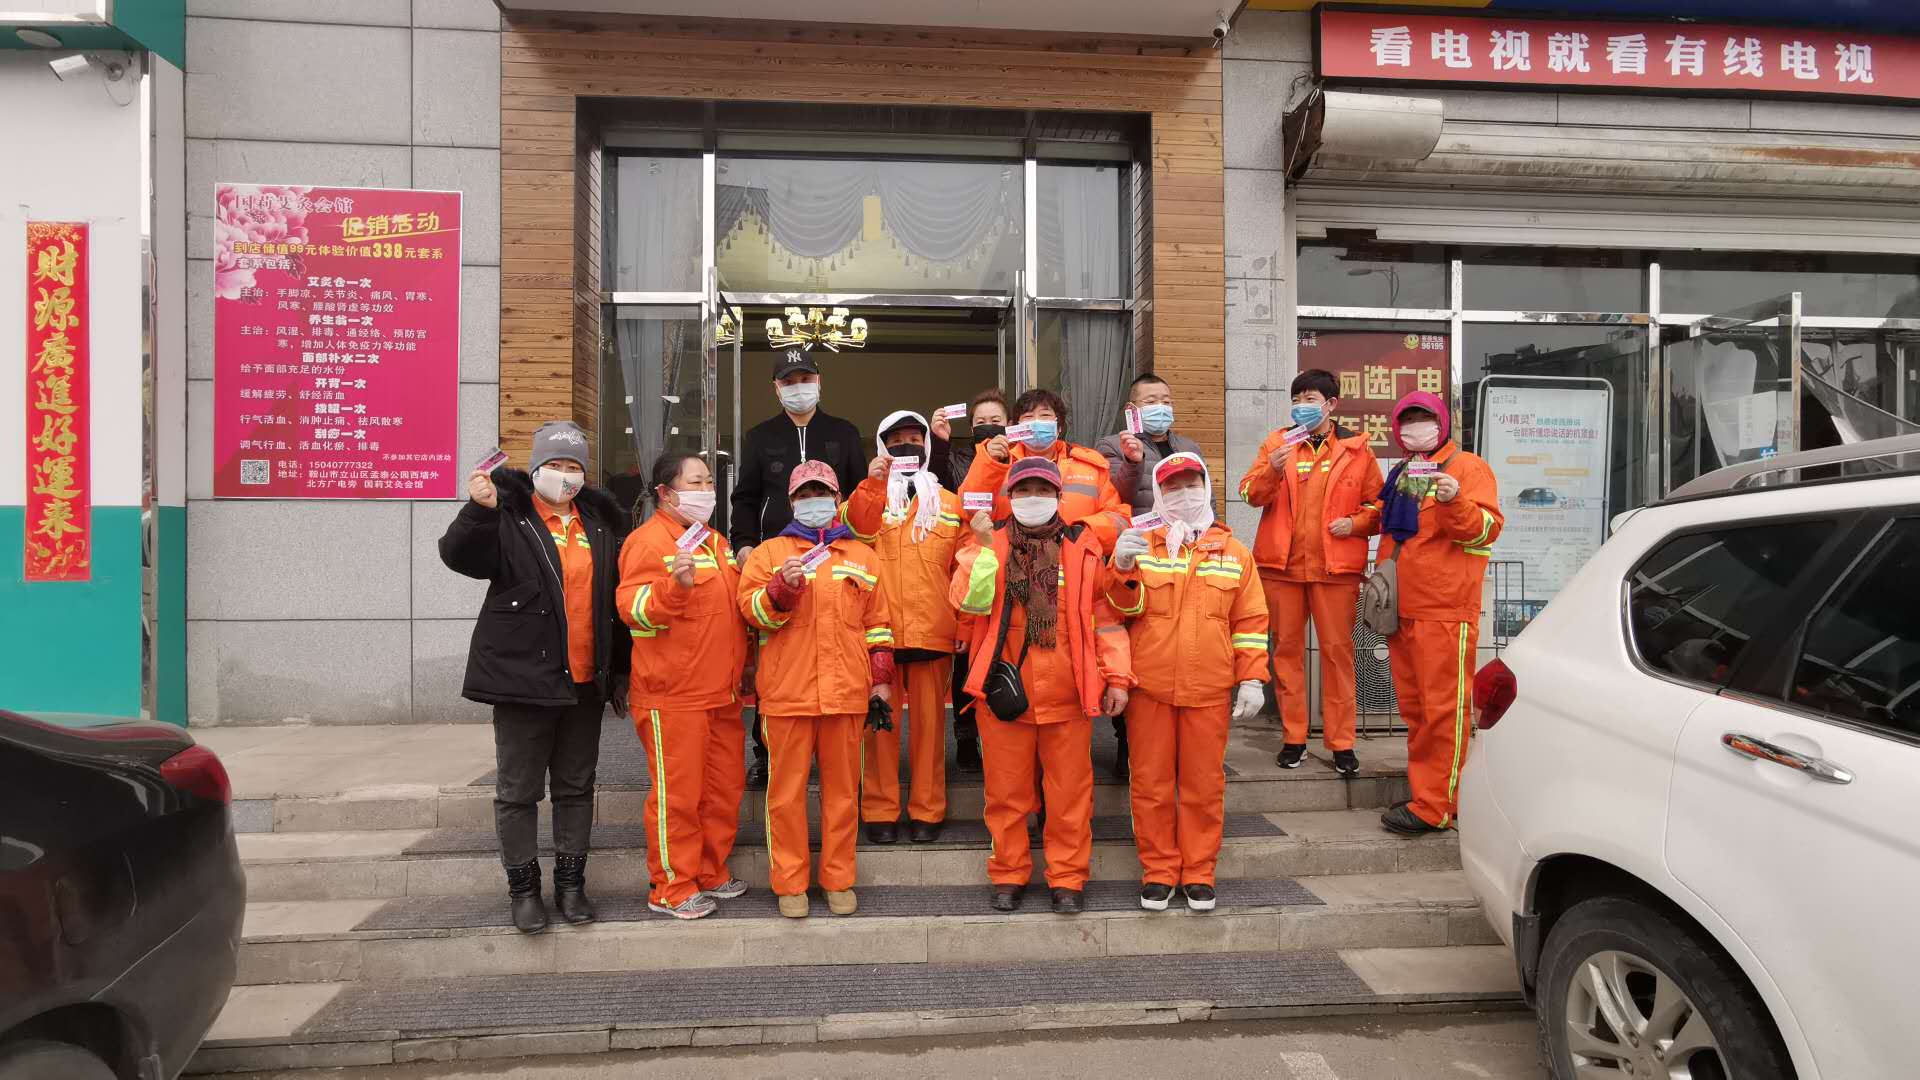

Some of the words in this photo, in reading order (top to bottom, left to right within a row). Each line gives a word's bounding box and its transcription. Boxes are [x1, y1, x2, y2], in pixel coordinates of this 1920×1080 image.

[1369, 25, 1875, 84] 看电视就看有线电视
[235, 195, 354, 214] 国莉艾灸会馆
[342, 211, 440, 237] 促销活动
[233, 241, 444, 260] 到店储值99元体验价值338元套系
[301, 352, 380, 364] 面部补水二次
[787, 350, 802, 362] NY
[239, 364, 345, 375] 给予面部充足的水份
[314, 378, 367, 389] 开背一次
[314, 429, 366, 440] 刮痧一次
